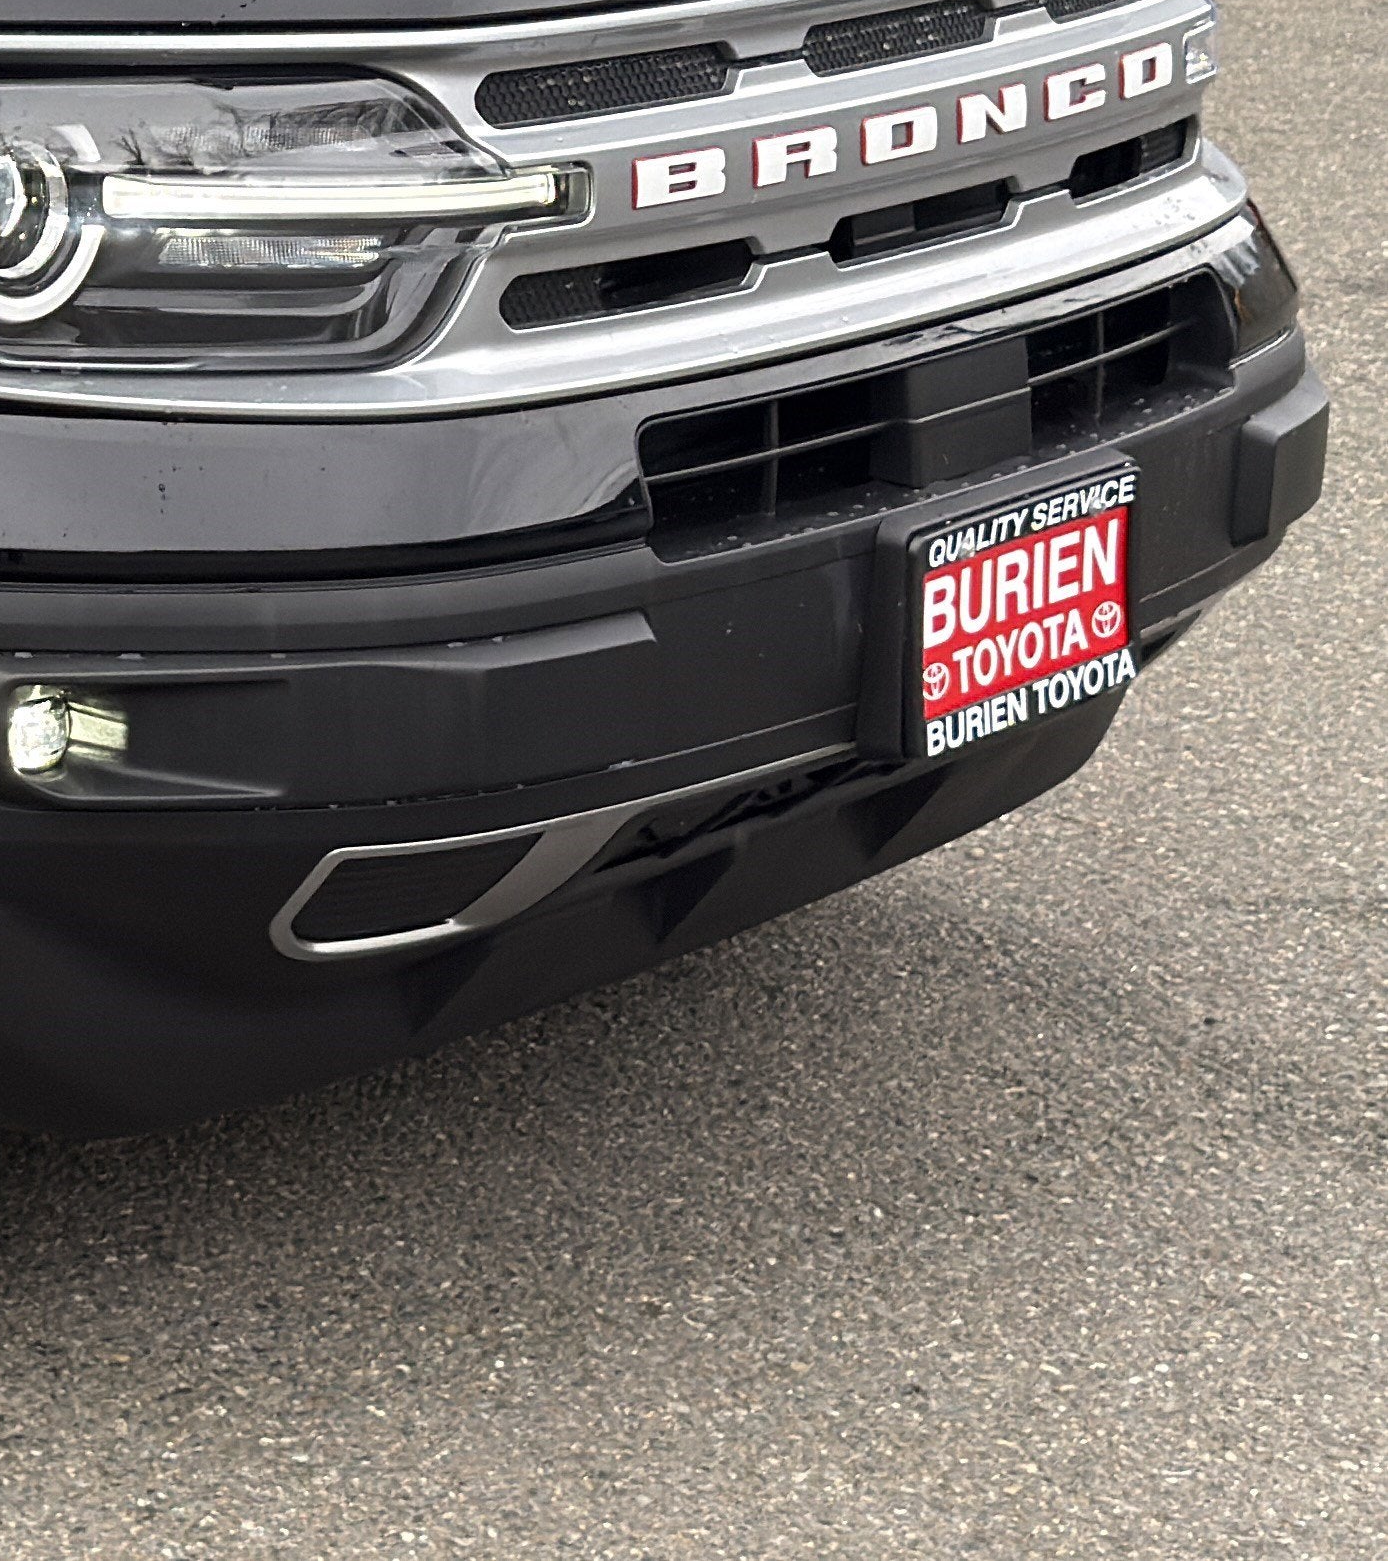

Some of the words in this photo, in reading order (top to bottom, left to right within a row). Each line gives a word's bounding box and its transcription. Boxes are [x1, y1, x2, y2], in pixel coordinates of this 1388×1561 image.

[631, 41, 1173, 211] BRONCO
[928, 509, 1027, 568] QUALITY
[1032, 474, 1136, 531] SERVICE
[923, 518, 1119, 650] BURIEN
[926, 689, 1028, 758] BURIEN
[1032, 649, 1137, 715] TOYOTA
[952, 609, 1090, 695] TOYOTA
